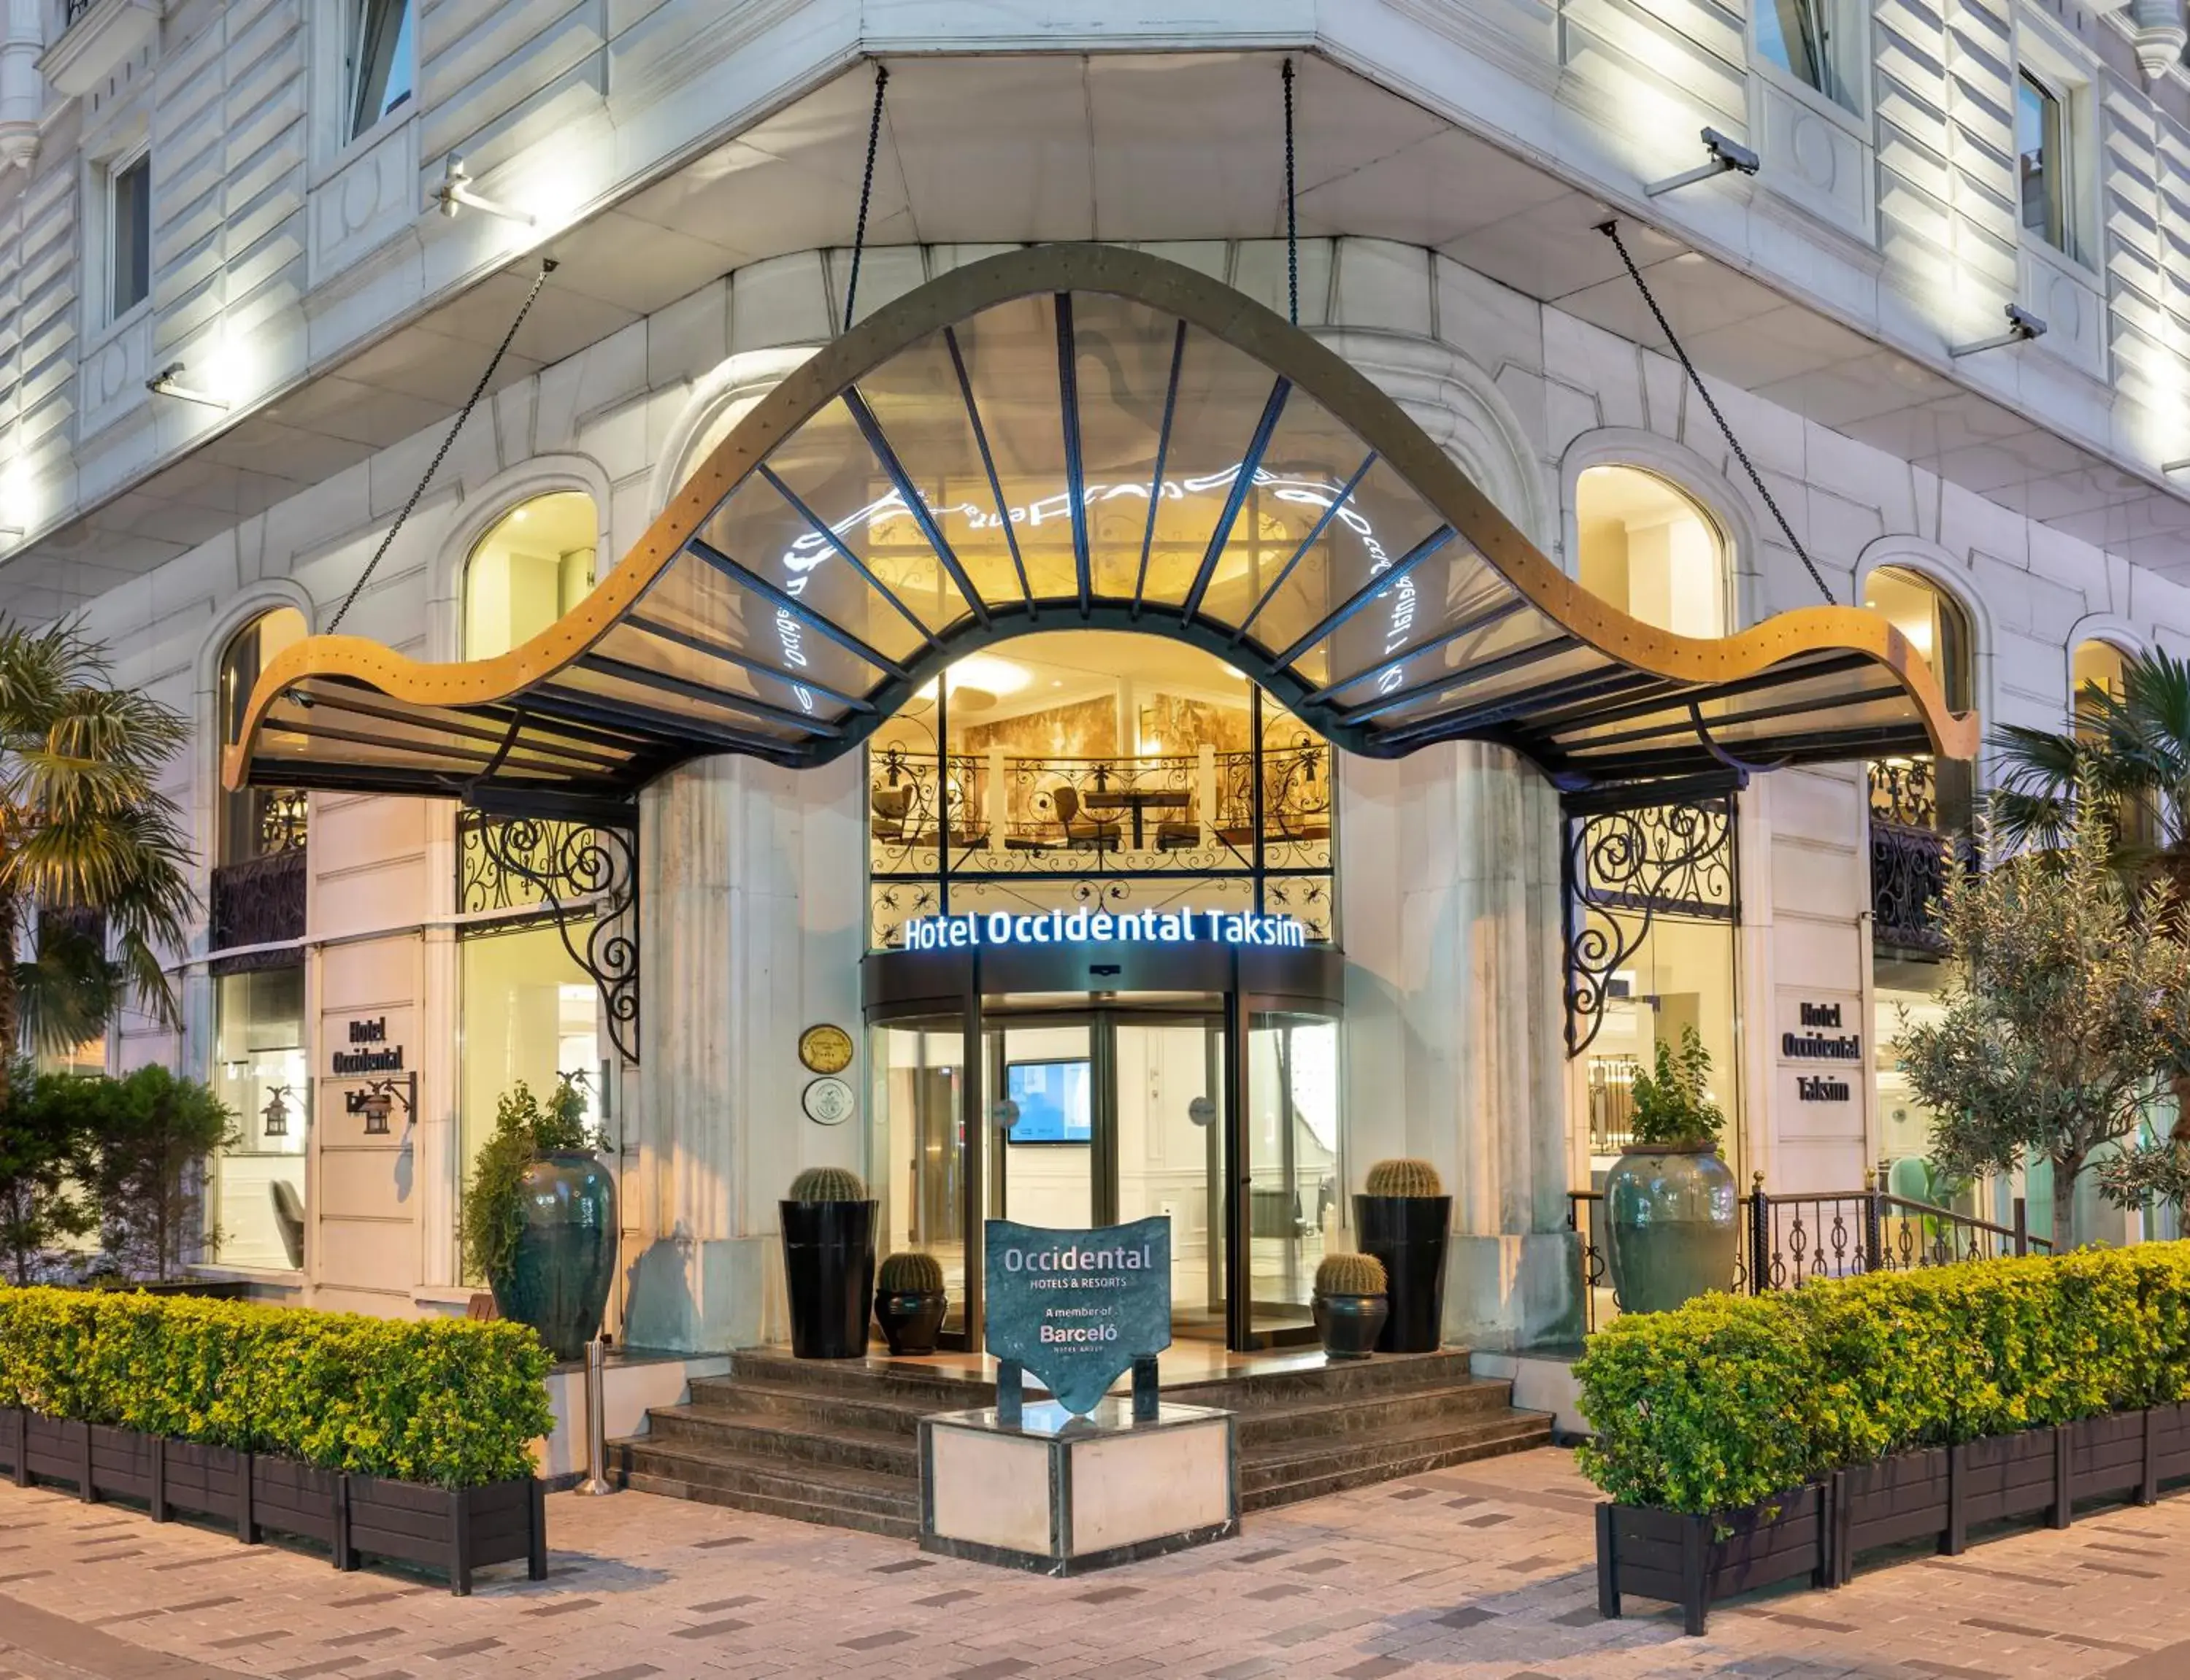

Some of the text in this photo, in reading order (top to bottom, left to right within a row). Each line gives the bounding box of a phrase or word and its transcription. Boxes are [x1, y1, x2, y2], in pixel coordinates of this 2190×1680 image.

[904, 906, 1305, 950] Hotel Occidental Taksim
[1799, 1002, 1843, 1028] Hotel
[349, 1016, 387, 1043] Hotel
[1782, 1031, 1861, 1059] Occidental
[333, 1044, 404, 1074] Occidental
[1796, 1075, 1850, 1101] Taksim
[1004, 1244, 1153, 1272] Occidental
[1029, 1277, 1127, 1290] HOTELS & RESORTS
[1045, 1305, 1112, 1317] A member of
[1040, 1323, 1118, 1343] Barceló
